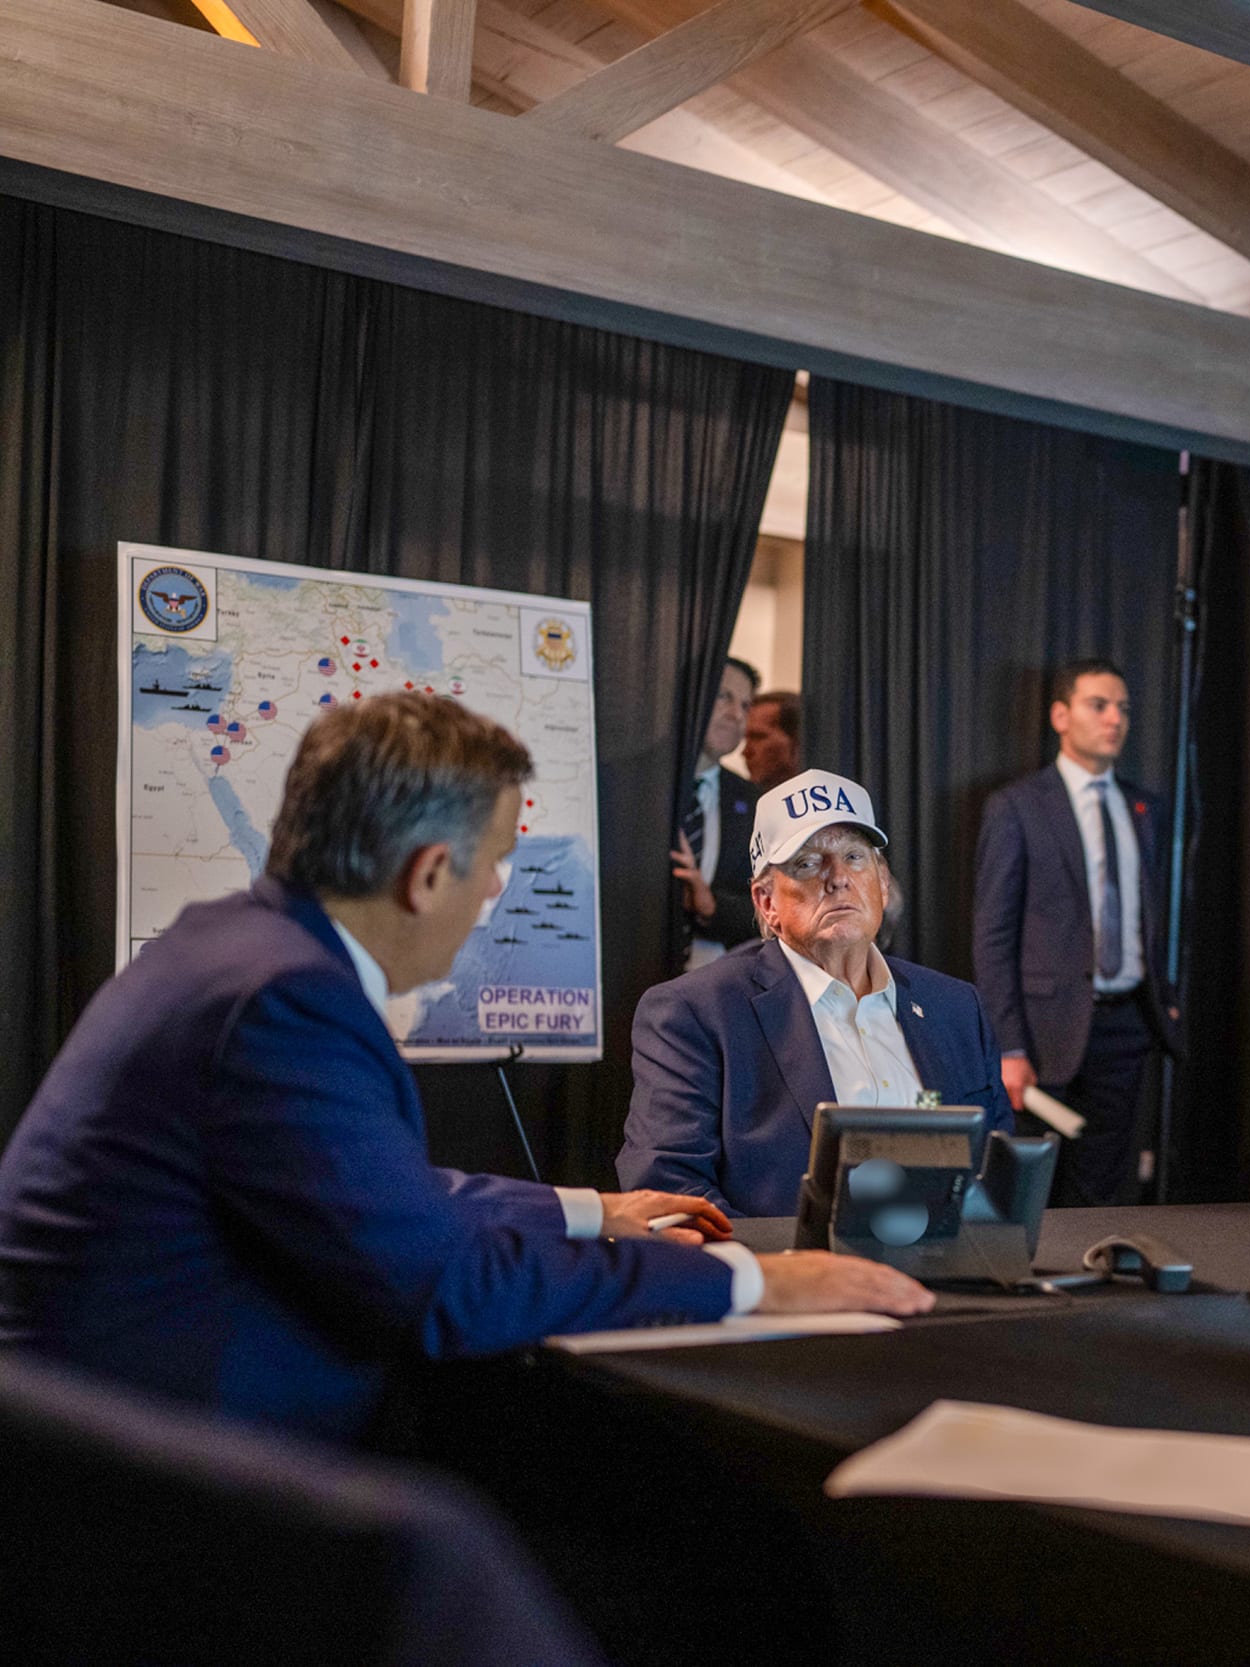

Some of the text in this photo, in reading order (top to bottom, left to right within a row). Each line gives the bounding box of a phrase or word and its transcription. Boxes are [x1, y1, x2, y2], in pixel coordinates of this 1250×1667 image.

[143, 783, 165, 793] Egypt
[782, 785, 857, 819] USA
[480, 987, 589, 1006] OPERATION
[486, 1012, 584, 1030] EPIC FURY
